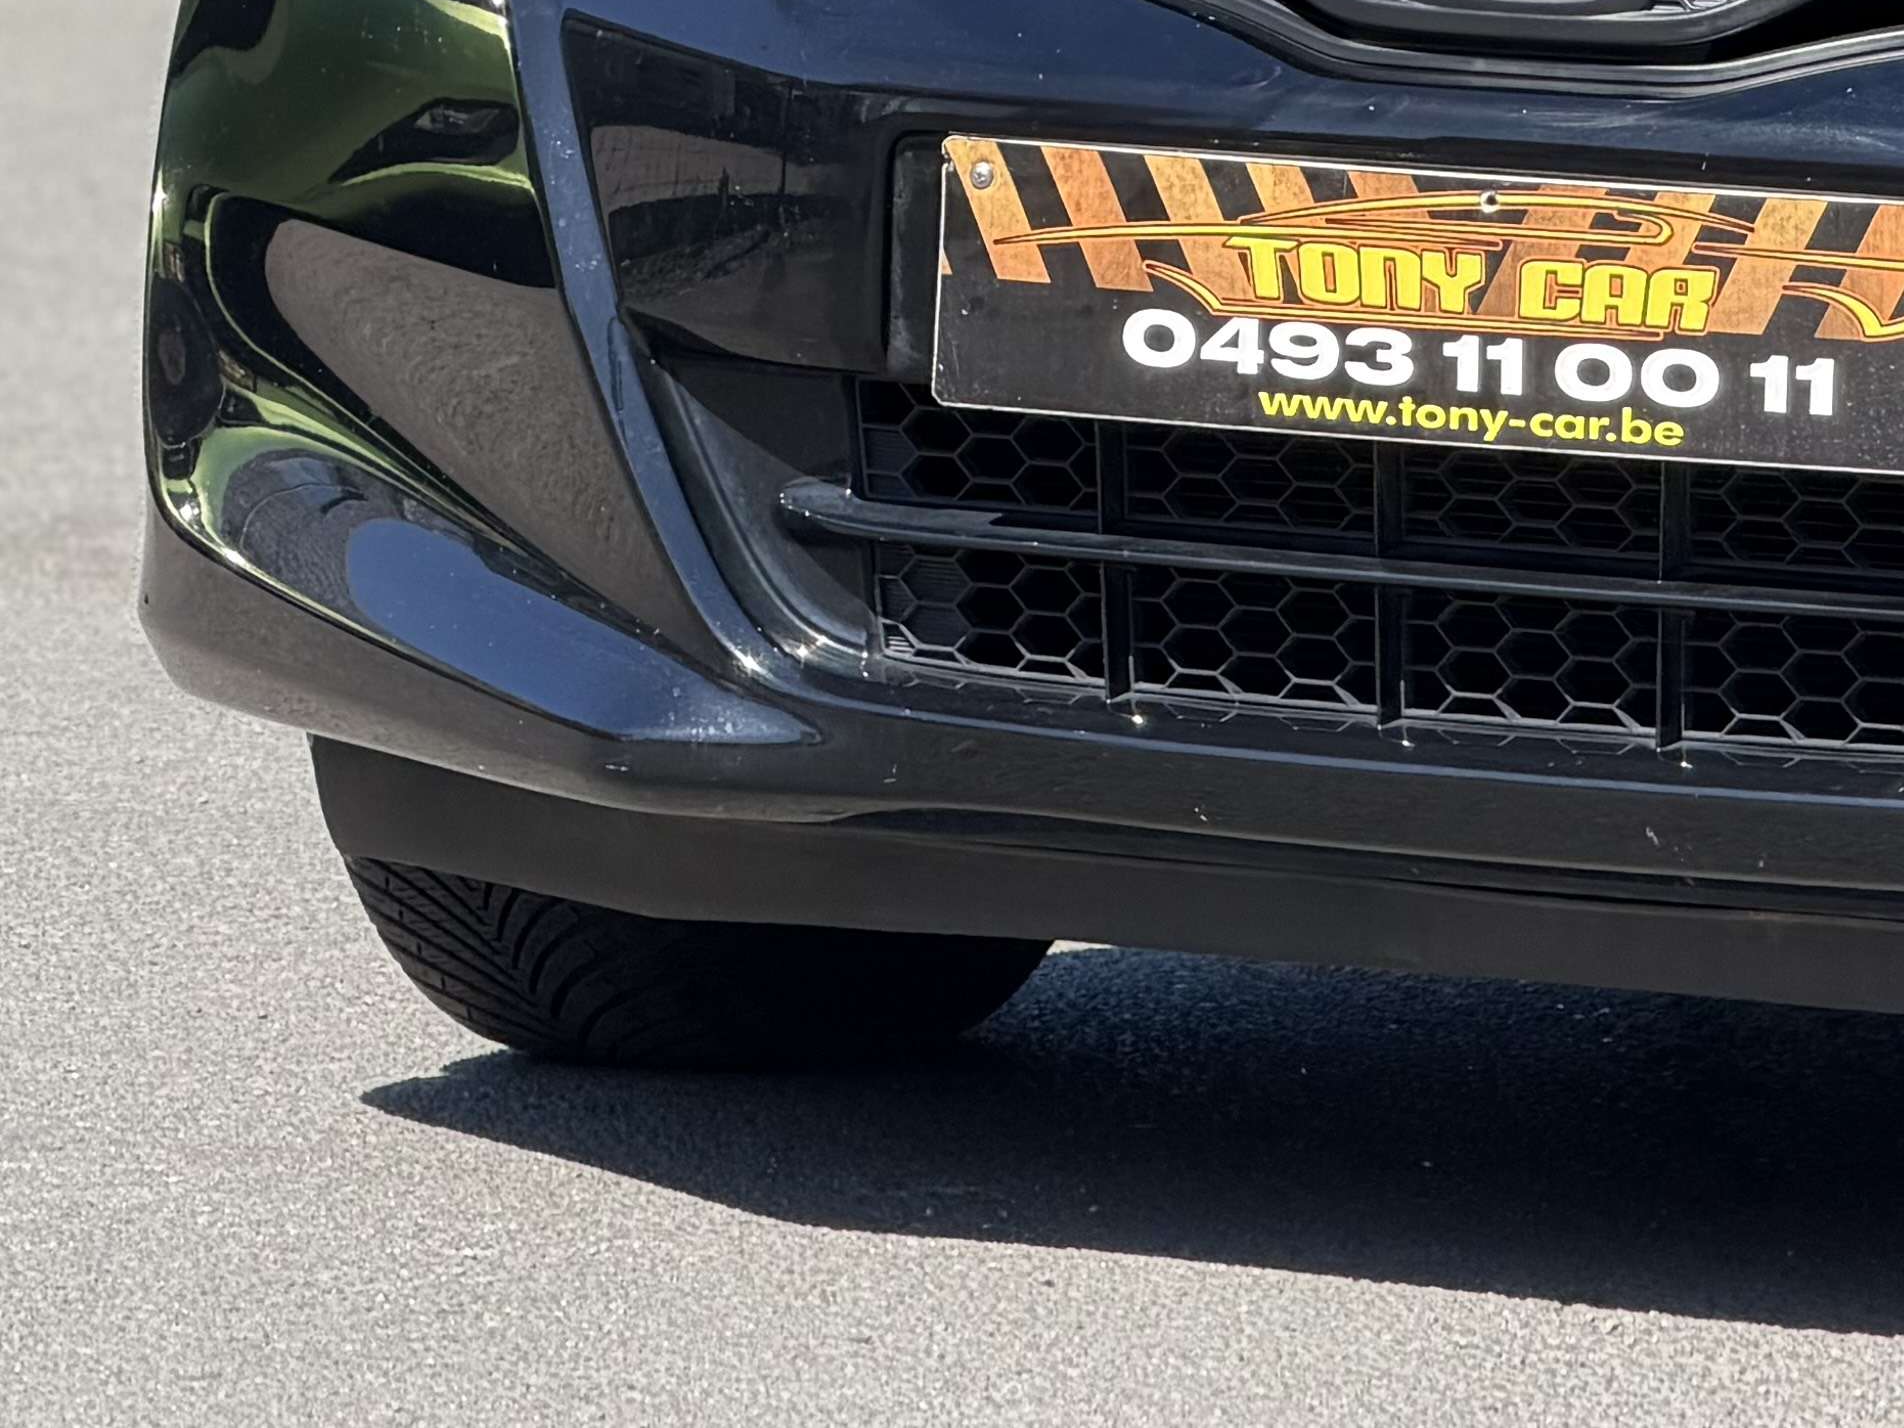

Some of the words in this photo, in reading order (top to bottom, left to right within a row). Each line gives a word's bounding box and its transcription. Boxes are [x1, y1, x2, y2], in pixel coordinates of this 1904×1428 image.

[1222, 234, 1486, 315] TONY
[1518, 258, 1719, 334] CAR
[1122, 308, 1414, 386] 0493
[1443, 334, 1523, 396] 11
[1554, 343, 1720, 407] 00
[1749, 355, 1835, 416] 11
[1258, 391, 1686, 446] www.tony-car.be
